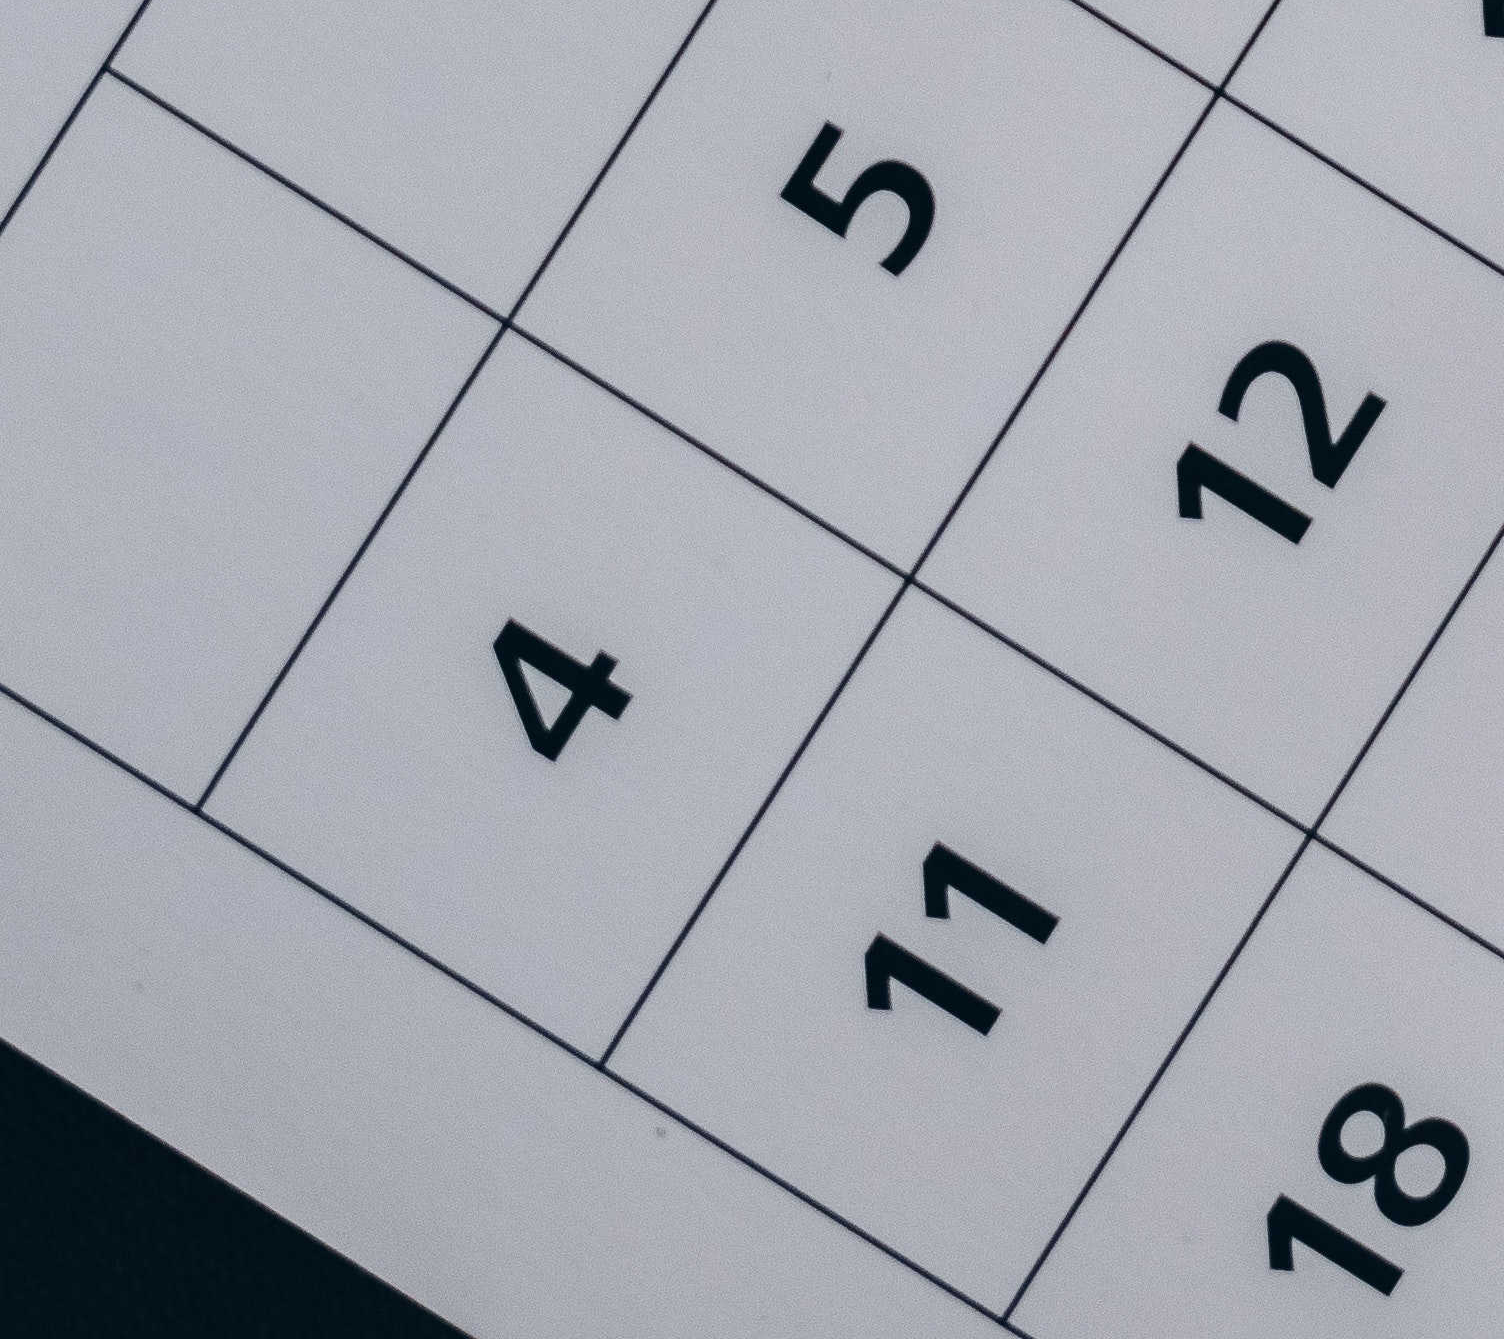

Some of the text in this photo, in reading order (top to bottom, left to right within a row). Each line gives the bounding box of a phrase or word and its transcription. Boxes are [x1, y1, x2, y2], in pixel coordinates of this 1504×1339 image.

[780, 122, 935, 276] 5
[1177, 340, 1386, 544] 12
[493, 619, 633, 761] 4
[865, 842, 1059, 1036] 11
[1267, 1083, 1469, 1296] 18
